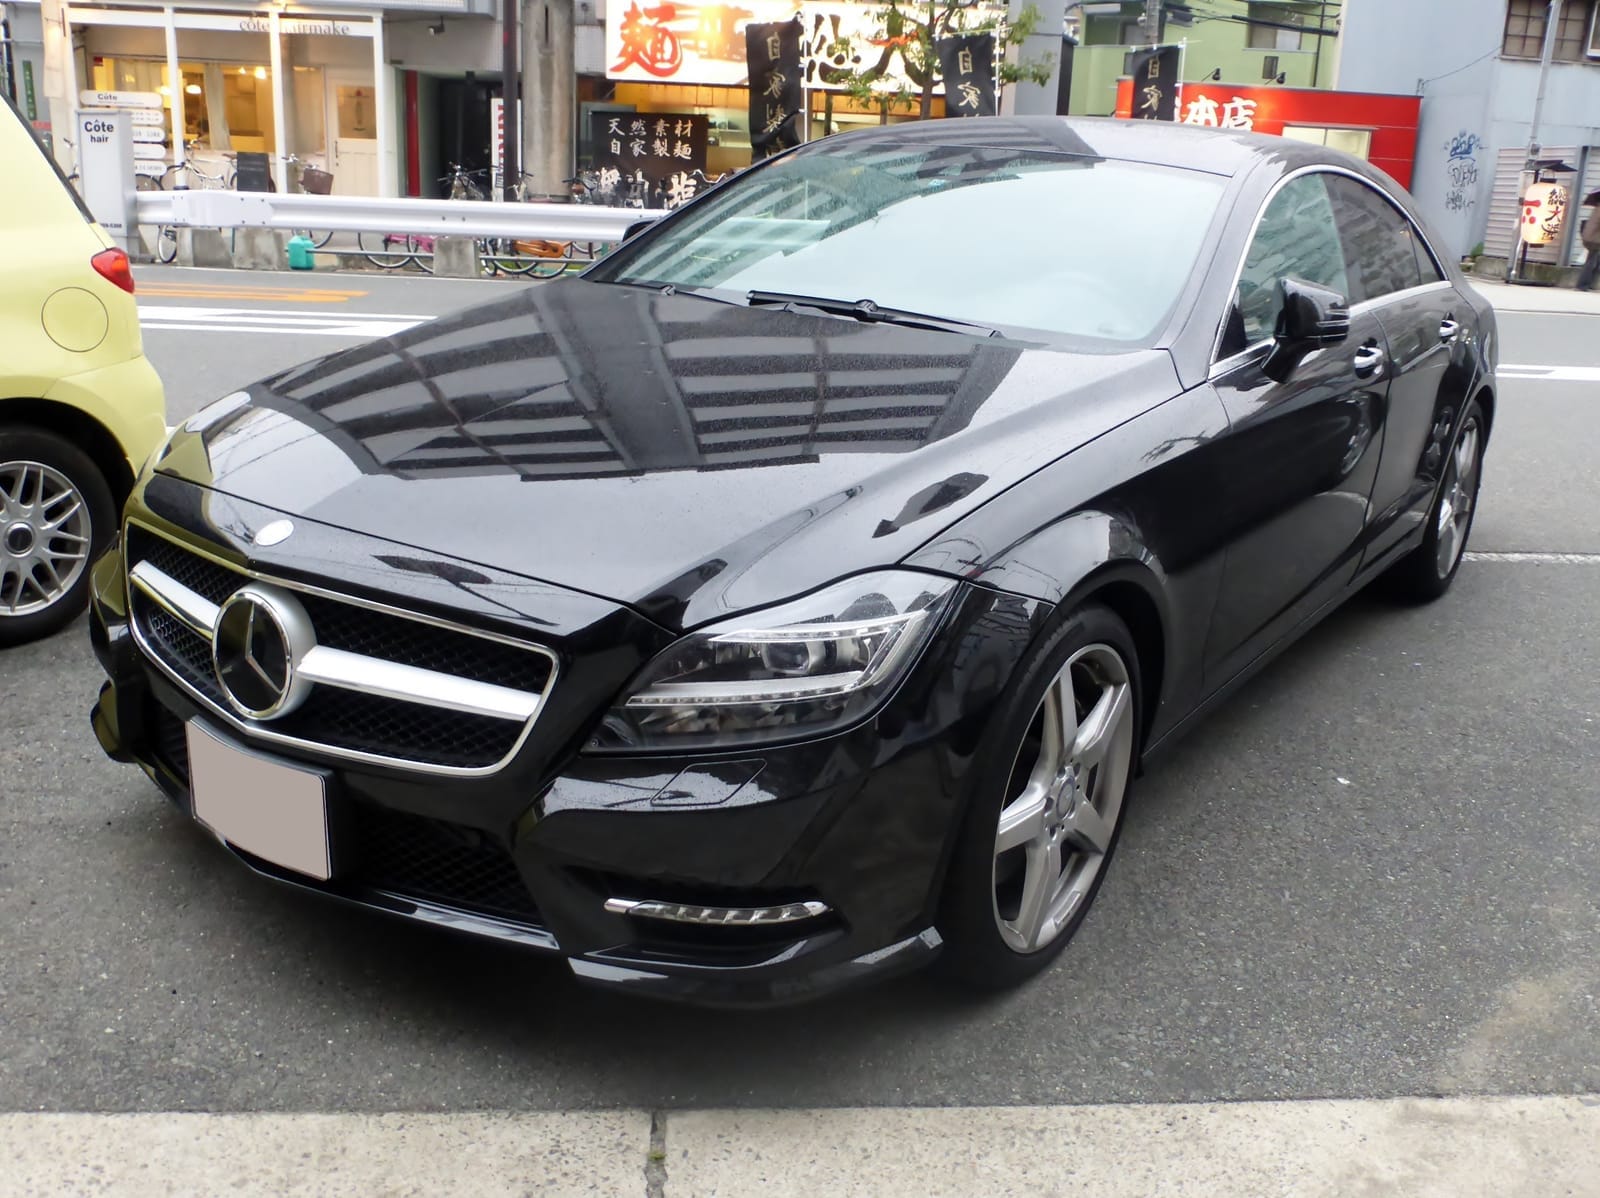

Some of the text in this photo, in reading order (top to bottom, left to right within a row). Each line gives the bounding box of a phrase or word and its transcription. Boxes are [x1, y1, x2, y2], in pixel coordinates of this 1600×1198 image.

[610, 0, 683, 78] 麺
[84, 119, 115, 133] Côte
[608, 118, 693, 137] 天然素材
[90, 134, 110, 143] hair
[611, 138, 692, 160] 自家製麺
